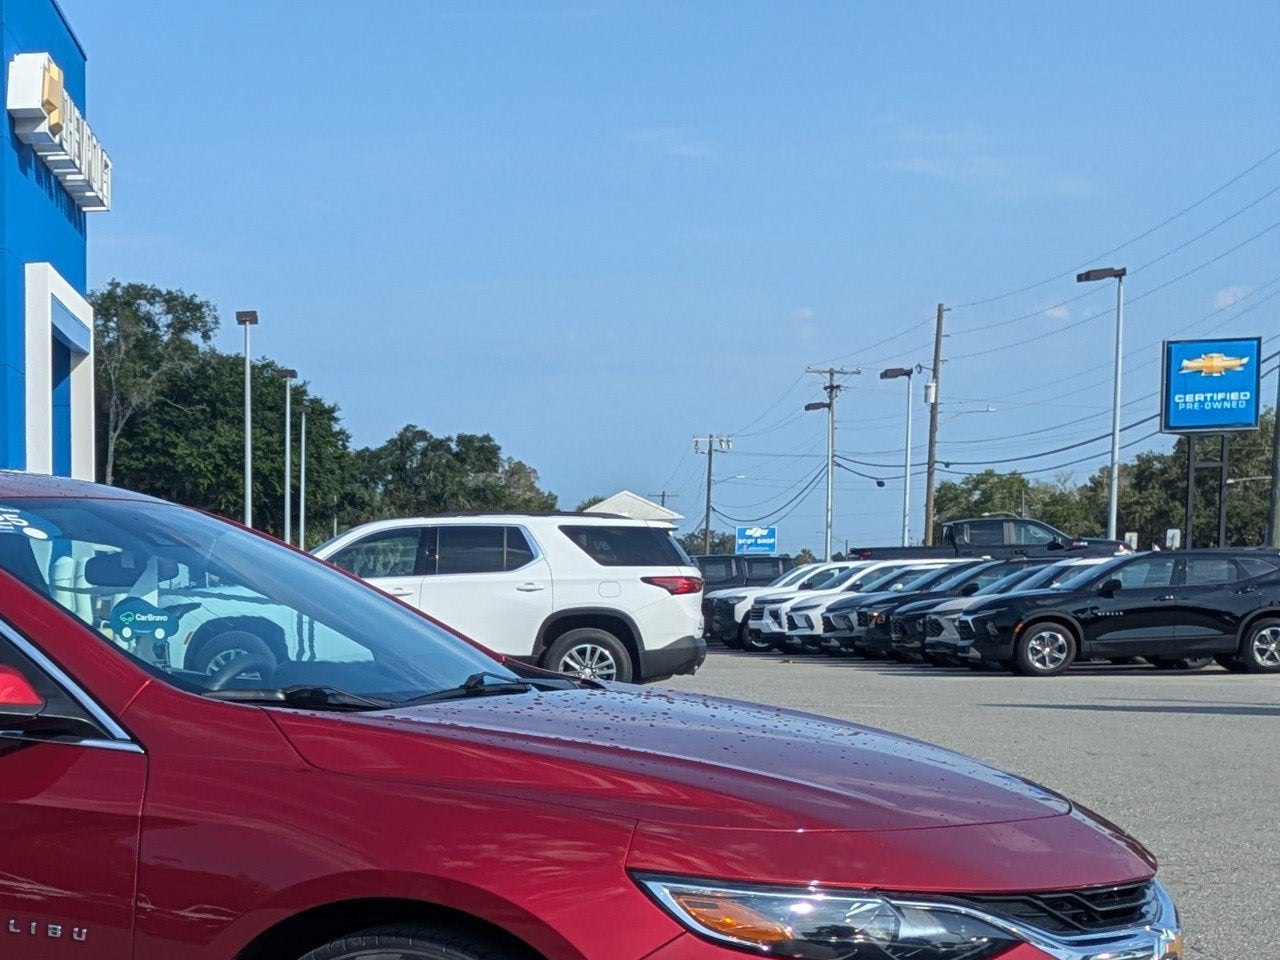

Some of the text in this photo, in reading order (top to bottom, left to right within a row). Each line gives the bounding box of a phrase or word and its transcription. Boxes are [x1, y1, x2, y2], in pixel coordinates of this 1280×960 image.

[1175, 391, 1251, 403] CERTIFIED
[1179, 400, 1246, 411] PRE-OWNED
[135, 613, 168, 621] CarBravo
